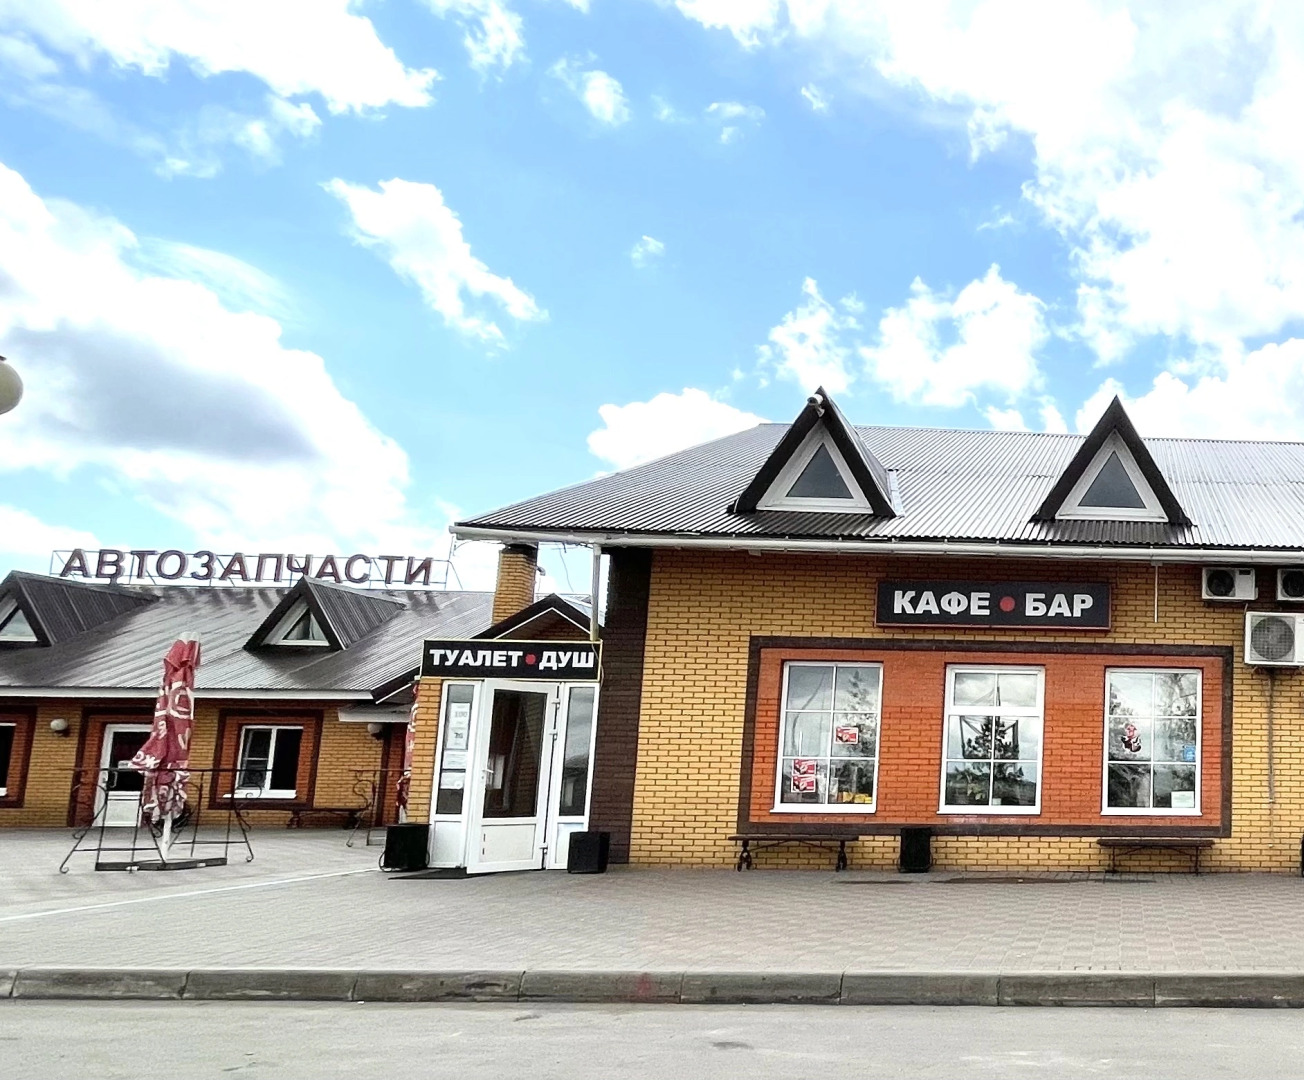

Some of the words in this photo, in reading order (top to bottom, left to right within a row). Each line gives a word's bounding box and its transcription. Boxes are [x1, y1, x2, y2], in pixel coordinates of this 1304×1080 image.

[60, 549, 433, 585] АВТОЗАПЧАСТИ
[894, 590, 989, 615] КАФЕ
[1025, 593, 1094, 617] БАР
[429, 649, 523, 667] ТУАЛЕТ
[538, 651, 594, 670] ДУШ
